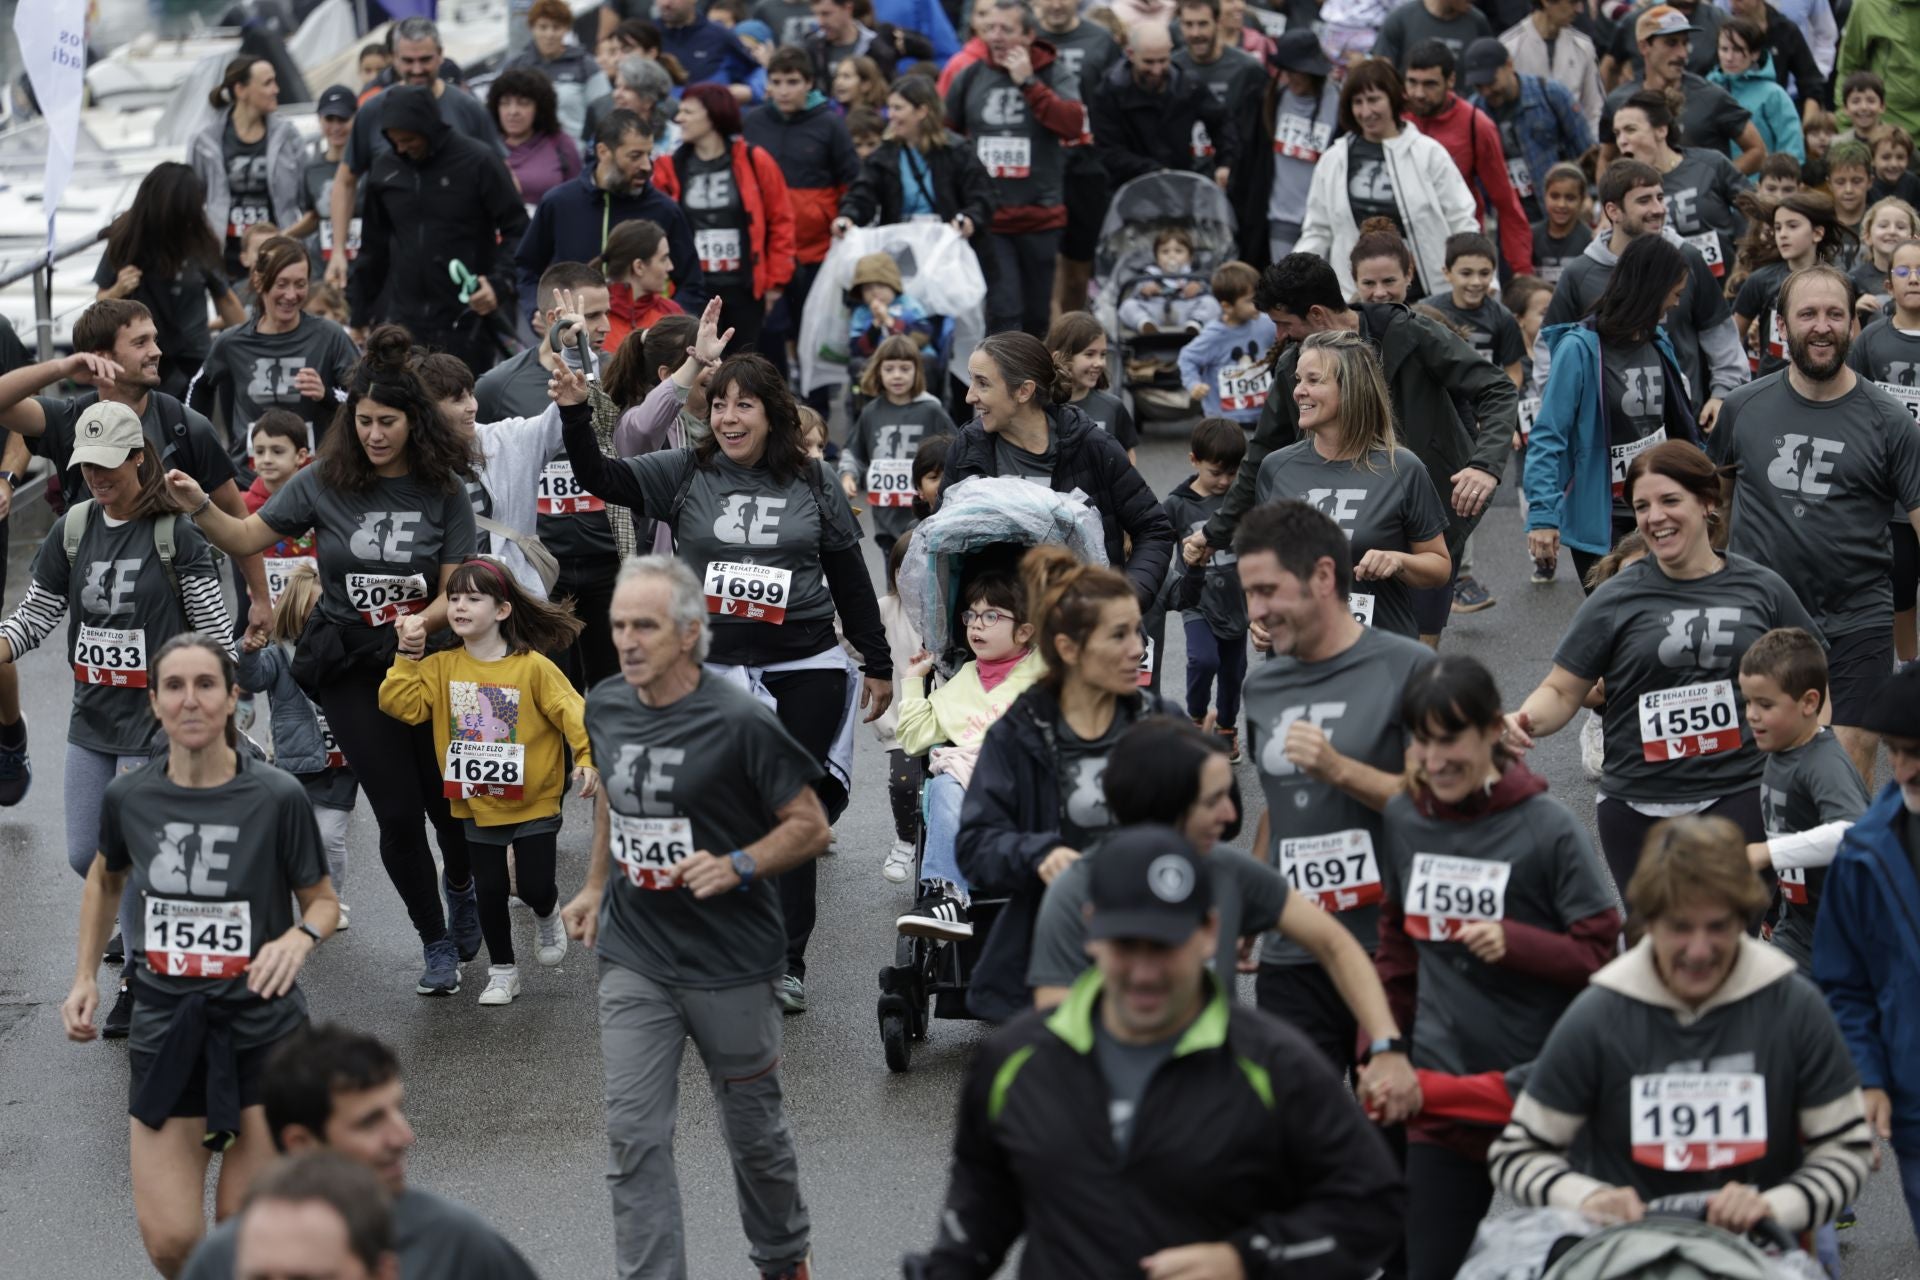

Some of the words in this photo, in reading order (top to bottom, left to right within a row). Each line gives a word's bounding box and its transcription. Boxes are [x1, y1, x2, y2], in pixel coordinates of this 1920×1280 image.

[702, 243, 737, 258] 198
[539, 476, 584, 496] 188
[871, 473, 909, 490] 208
[352, 583, 424, 610] 2032
[711, 574, 784, 604] 1699
[77, 642, 142, 669] 2033
[1688, 687, 1708, 697] ELZO
[1647, 702, 1731, 738] 1550
[450, 758, 519, 783] 1628
[617, 833, 687, 866] 1546
[1287, 853, 1366, 890] 1697
[1415, 881, 1497, 917] 1598
[154, 921, 244, 951] 1545
[1643, 1101, 1751, 1138] 1911
